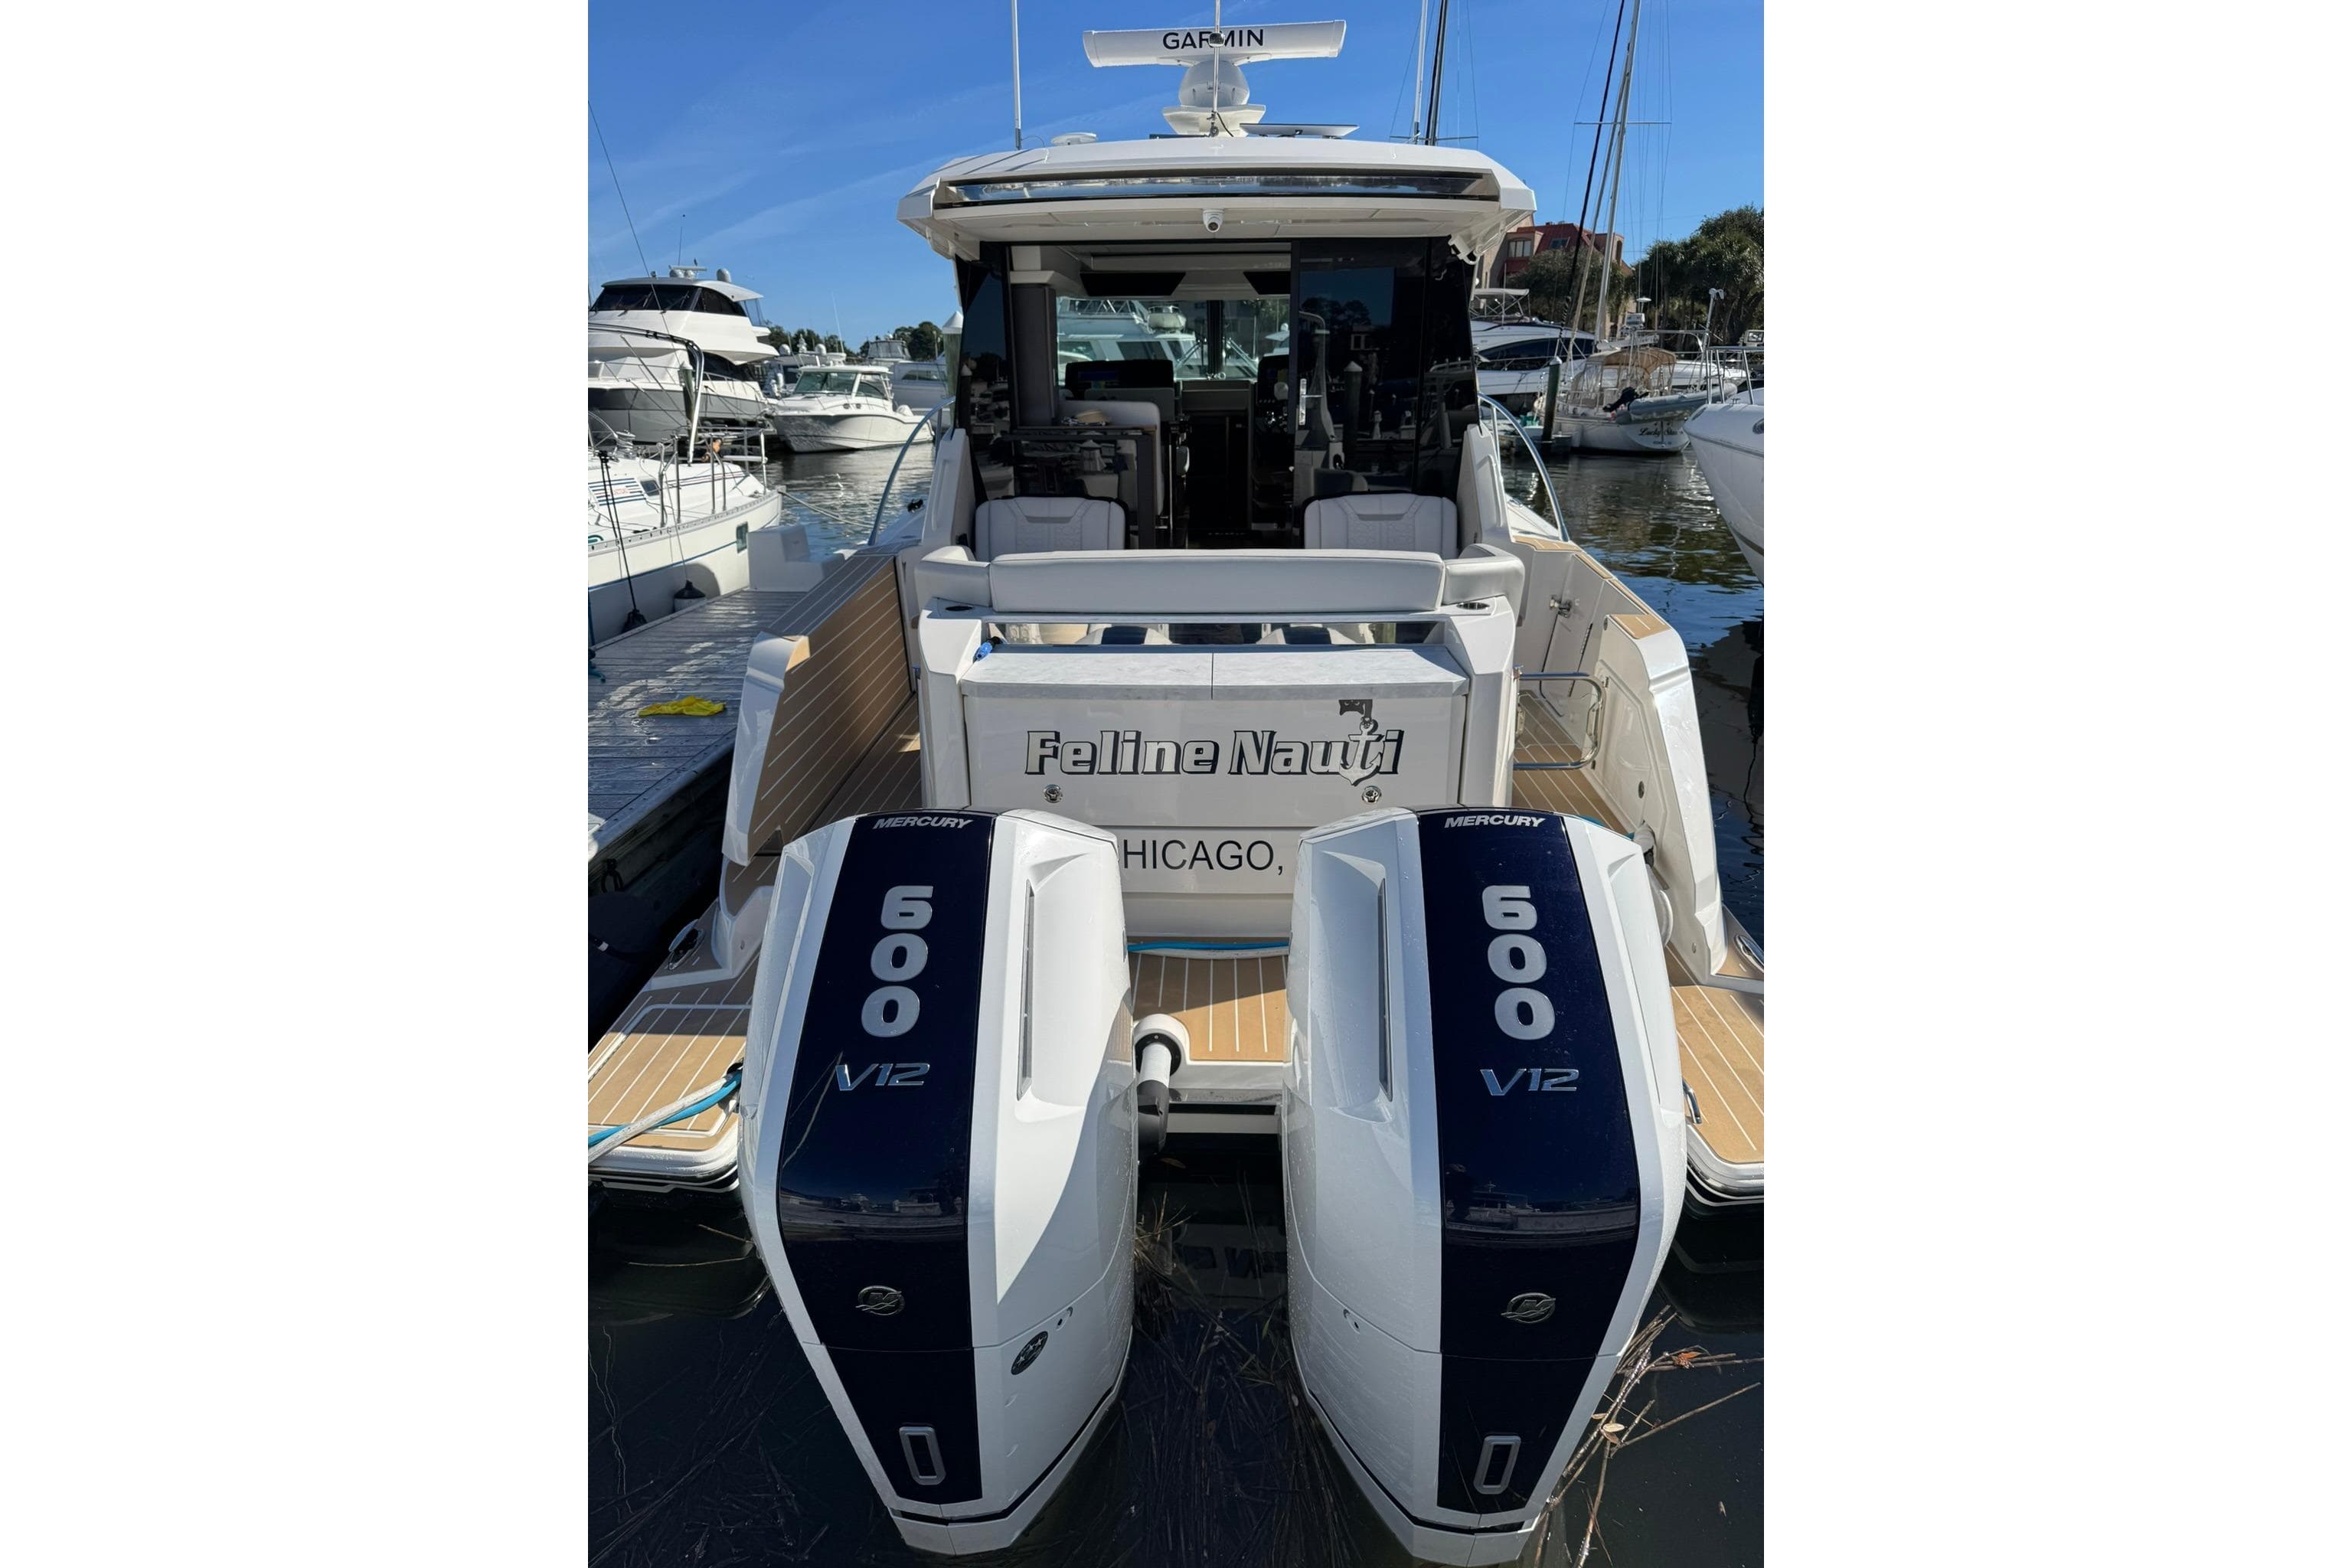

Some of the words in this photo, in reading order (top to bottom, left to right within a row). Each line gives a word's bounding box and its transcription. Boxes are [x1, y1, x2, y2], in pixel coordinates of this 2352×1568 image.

[1162, 29, 1263, 50] GARMIN
[1024, 730, 1220, 775] Feline
[1227, 729, 1404, 786] Nauti
[872, 816, 973, 829] MERCURY
[1444, 815, 1545, 828] MERCURY
[1122, 839, 1283, 876] HICAGO,
[861, 884, 933, 1038] 600
[1481, 884, 1556, 1040] 600
[835, 1063, 930, 1091] V12
[1479, 1067, 1579, 1096] V12
